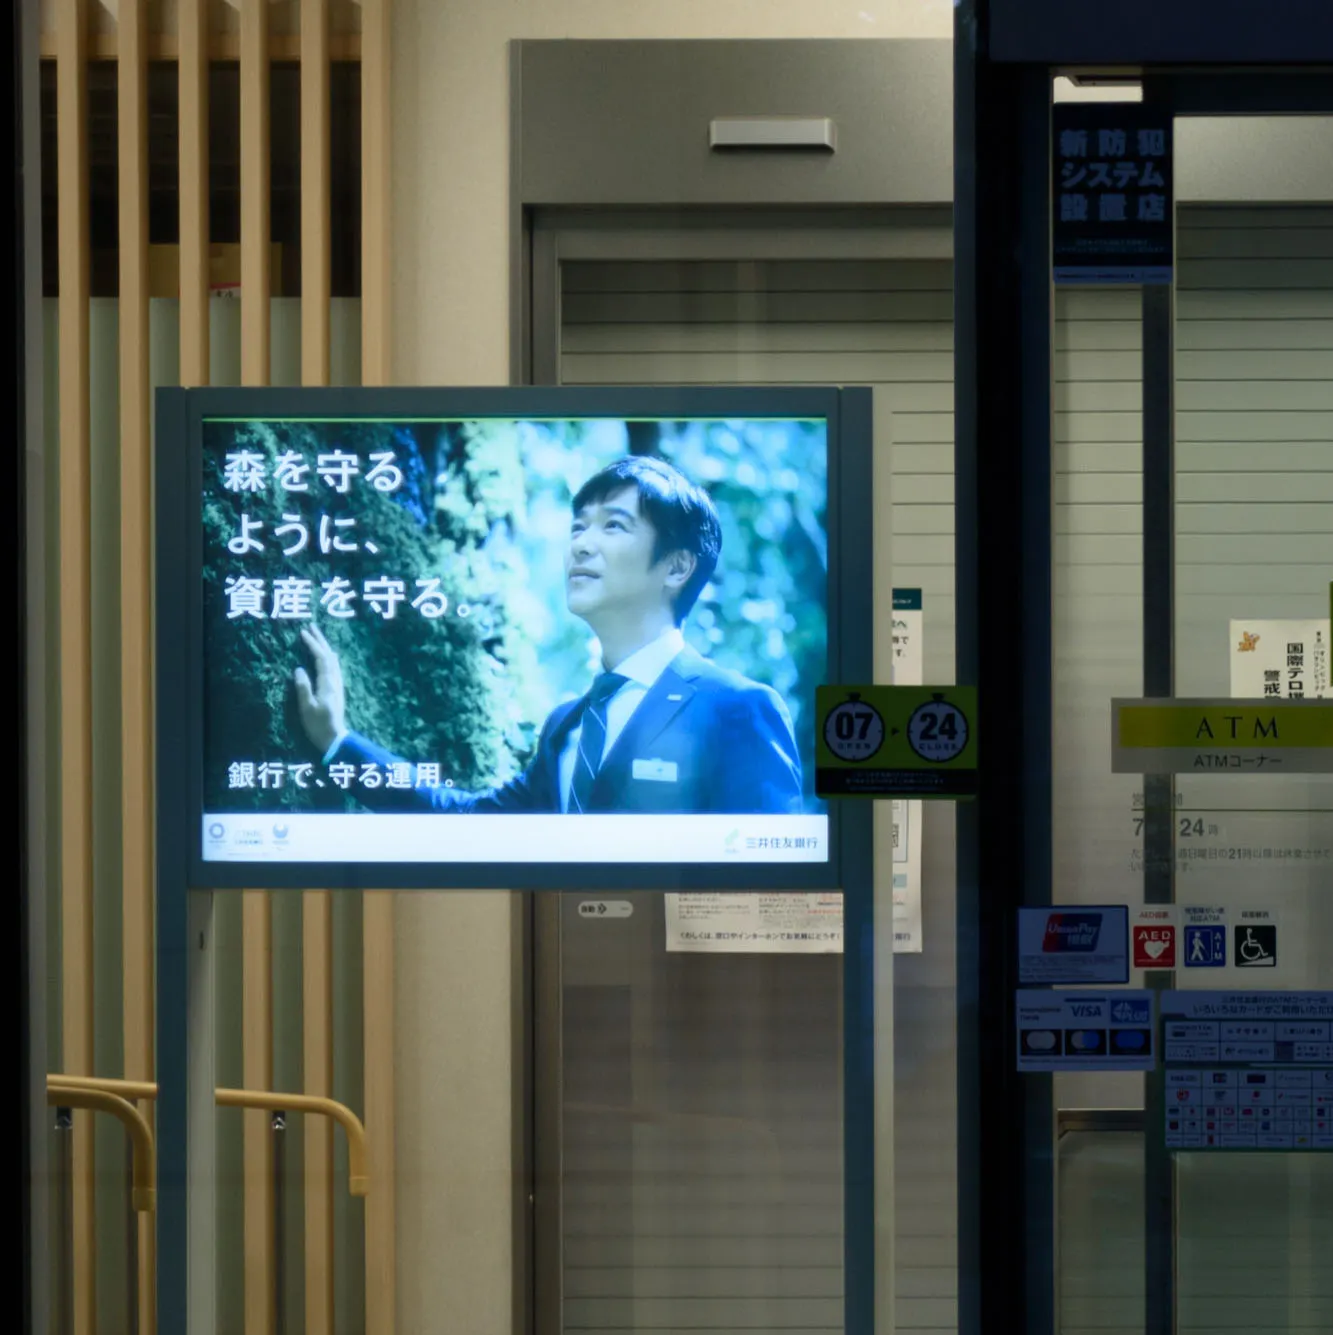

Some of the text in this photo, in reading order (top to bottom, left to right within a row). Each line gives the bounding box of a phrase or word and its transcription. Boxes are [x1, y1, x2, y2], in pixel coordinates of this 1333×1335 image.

[1060, 129, 1165, 157] 新防犯
[1061, 161, 1165, 188] システム
[1060, 193, 1165, 221] 設置店
[224, 449, 404, 492] 森を守る
[227, 513, 378, 555] ように、
[224, 575, 472, 619] 資産を守る。
[1264, 670, 1280, 698] 警戒
[836, 712, 957, 740] 07 24
[1196, 717, 1279, 739] ATM
[228, 761, 455, 789] 銀行で、守る運用。
[1194, 755, 1282, 768] ATMコーナー
[746, 836, 818, 849] 三井住友銀行
[1048, 922, 1100, 935] UnionPay
[1138, 930, 1171, 941] AED
[1214, 933, 1223, 960] ATM
[1072, 1005, 1102, 1018] VISA
